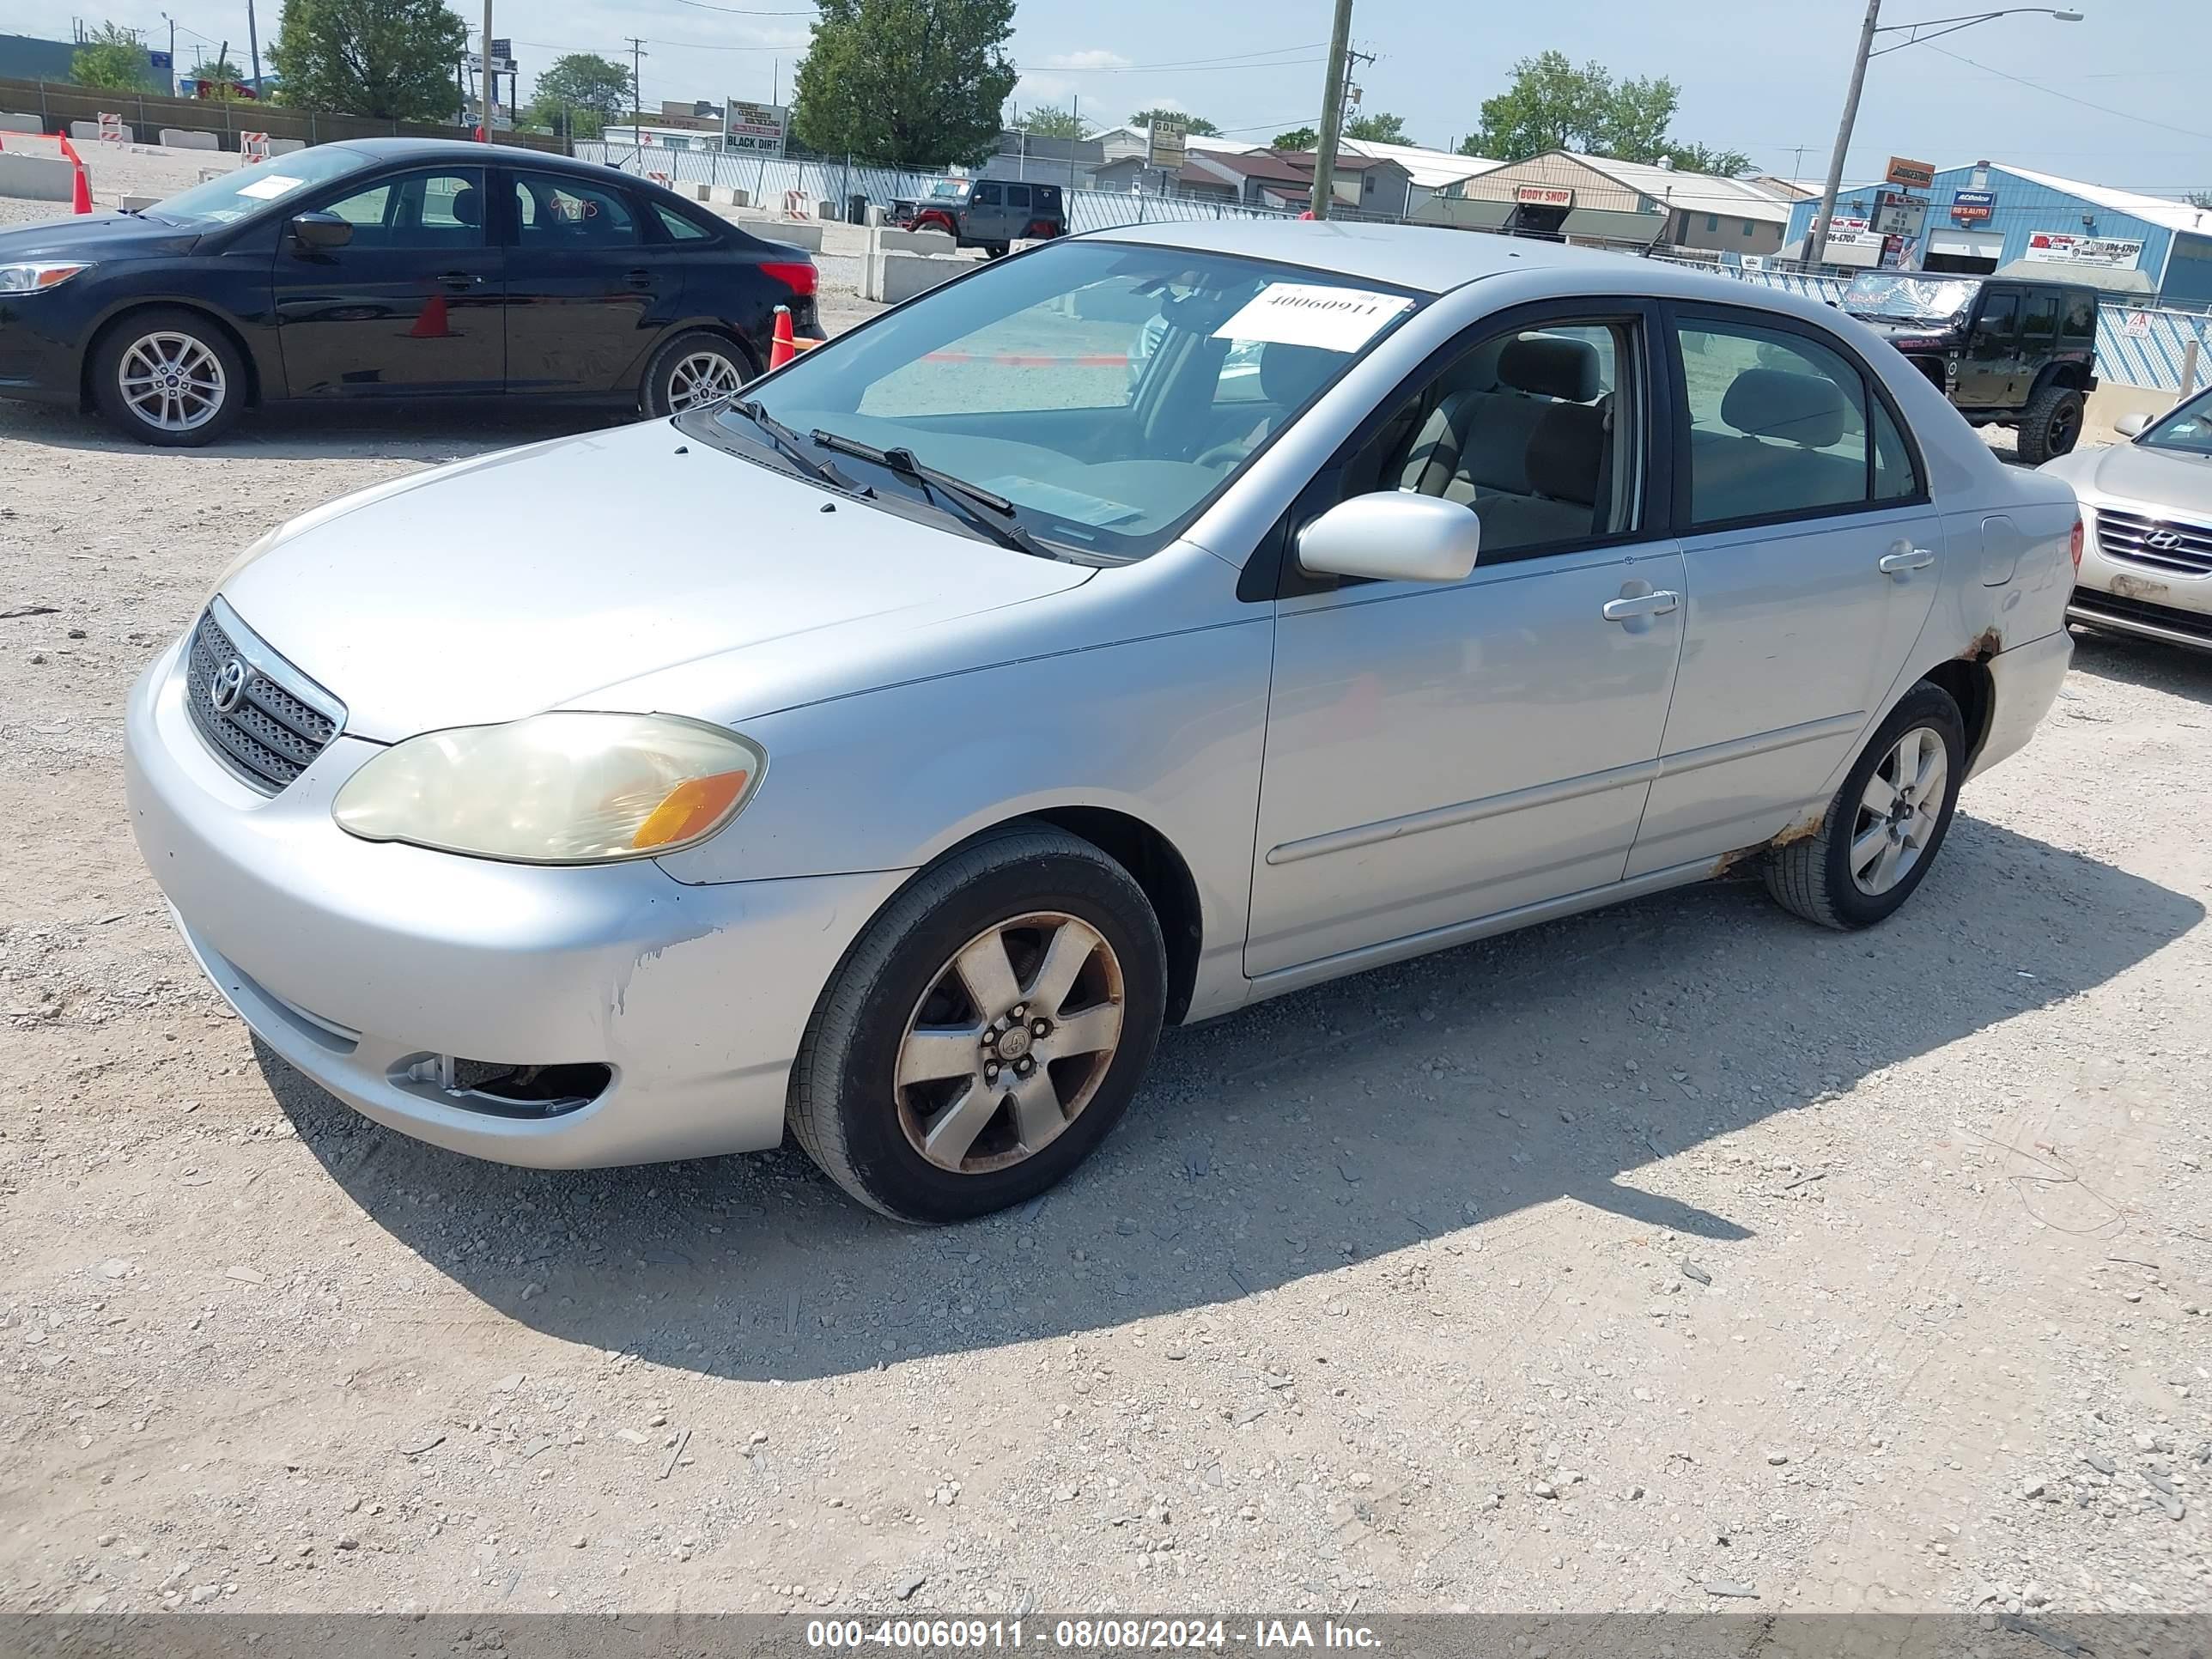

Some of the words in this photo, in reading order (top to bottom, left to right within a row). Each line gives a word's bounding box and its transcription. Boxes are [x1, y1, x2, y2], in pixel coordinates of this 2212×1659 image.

[1155, 122, 1176, 133] GDL
[727, 135, 756, 149] BLACK
[1520, 189, 1544, 200] BODY
[1545, 191, 1569, 203] SHOP
[1826, 234, 1856, 243] 96-5700
[2106, 242, 2140, 252] 596-5700
[1267, 295, 1378, 315] 40060911
